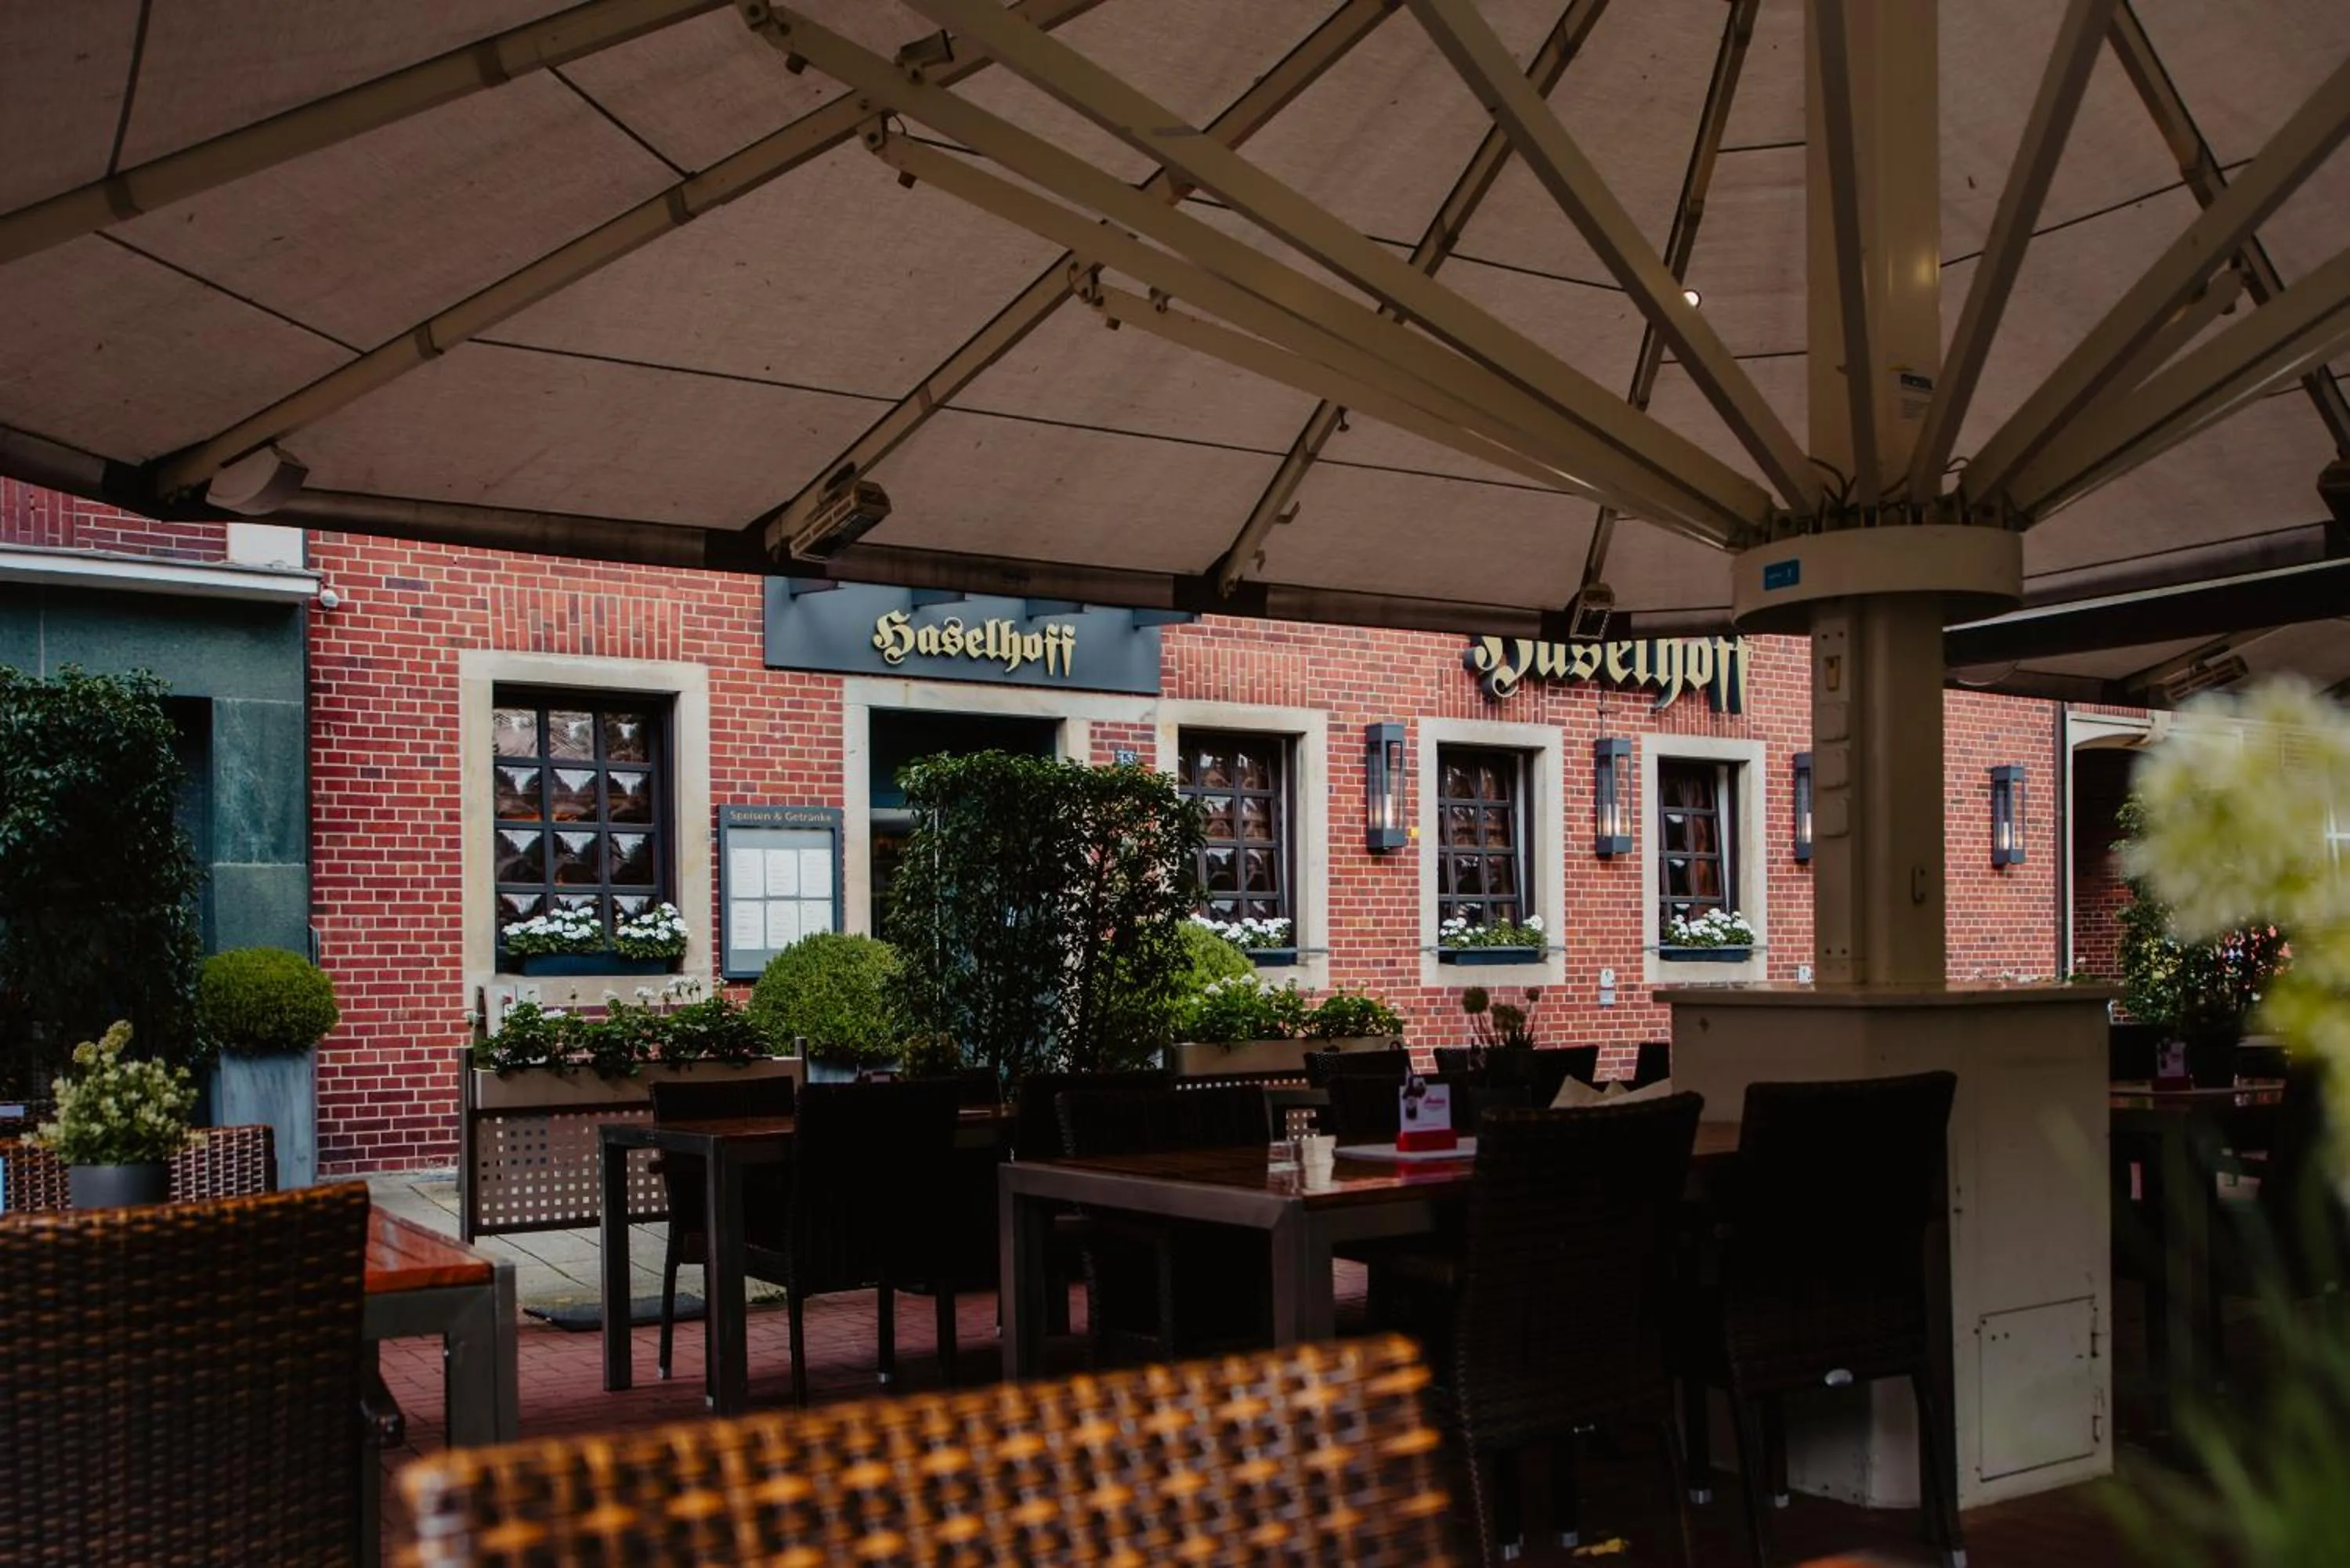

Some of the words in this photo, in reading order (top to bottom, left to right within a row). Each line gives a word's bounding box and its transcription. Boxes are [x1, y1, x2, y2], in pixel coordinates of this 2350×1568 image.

[873, 610, 1076, 677] Haselhoff
[730, 810, 771, 822] Speisen
[773, 811, 782, 821] &
